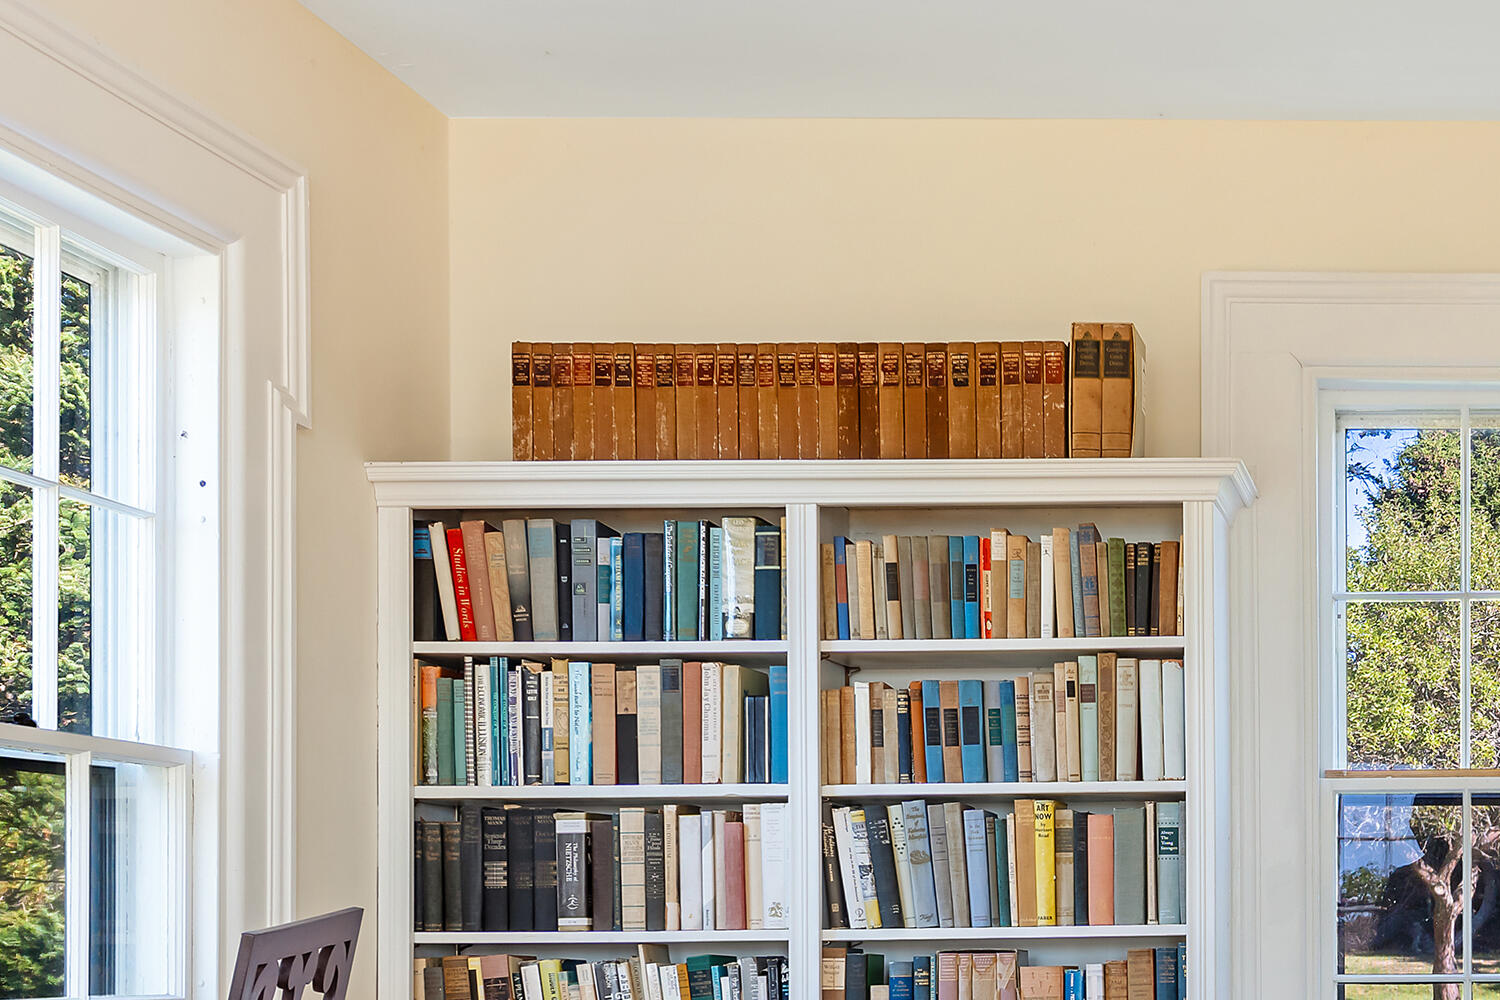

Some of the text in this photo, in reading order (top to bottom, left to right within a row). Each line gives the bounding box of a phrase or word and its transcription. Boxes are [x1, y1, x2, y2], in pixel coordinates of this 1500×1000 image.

[452, 547, 473, 629] Studies in Words
[478, 686, 486, 720] ECONOMIC
[702, 666, 712, 742] John Jay Chapman
[478, 721, 488, 756] ILLUSION
[1036, 804, 1050, 812] ART
[565, 842, 573, 882] NIETZSCHE
[748, 962, 758, 983] THE
